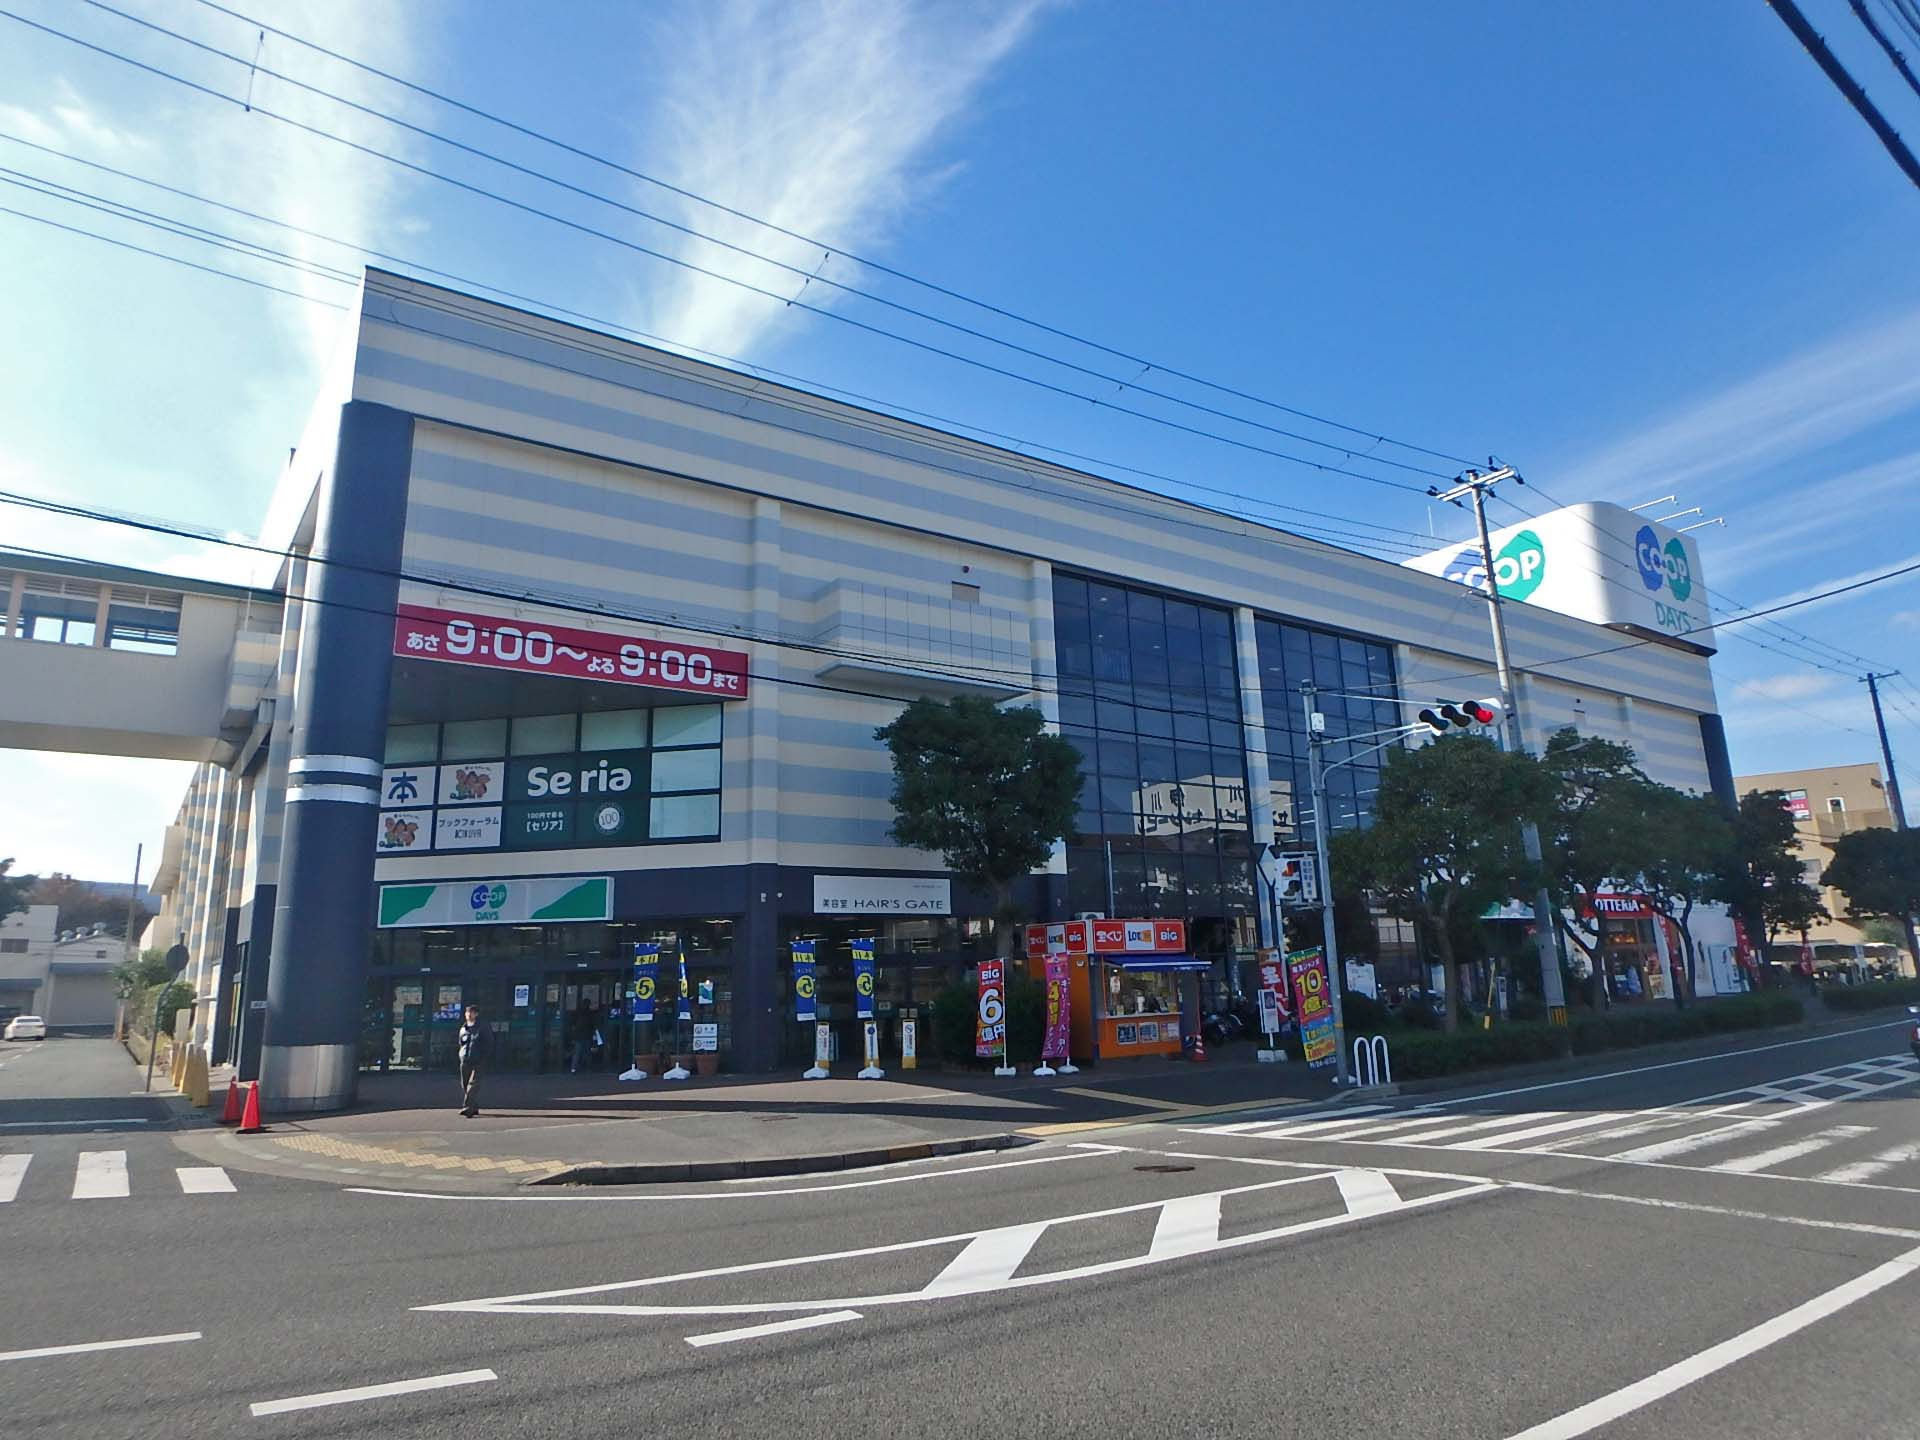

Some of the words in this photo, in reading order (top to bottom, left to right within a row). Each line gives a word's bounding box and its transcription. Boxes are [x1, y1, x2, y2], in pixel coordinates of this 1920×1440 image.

[1655, 600, 1691, 633] DAYS
[527, 760, 632, 797] Seria
[854, 899, 900, 909] HAIR'S
[904, 899, 943, 910] GATE
[475, 911, 499, 921] DAYS
[1068, 930, 1082, 943] BIG
[1160, 927, 1178, 941] BIG
[981, 966, 1000, 981] BIG
[1295, 968, 1322, 997] 10
[979, 987, 1003, 1025] 6
